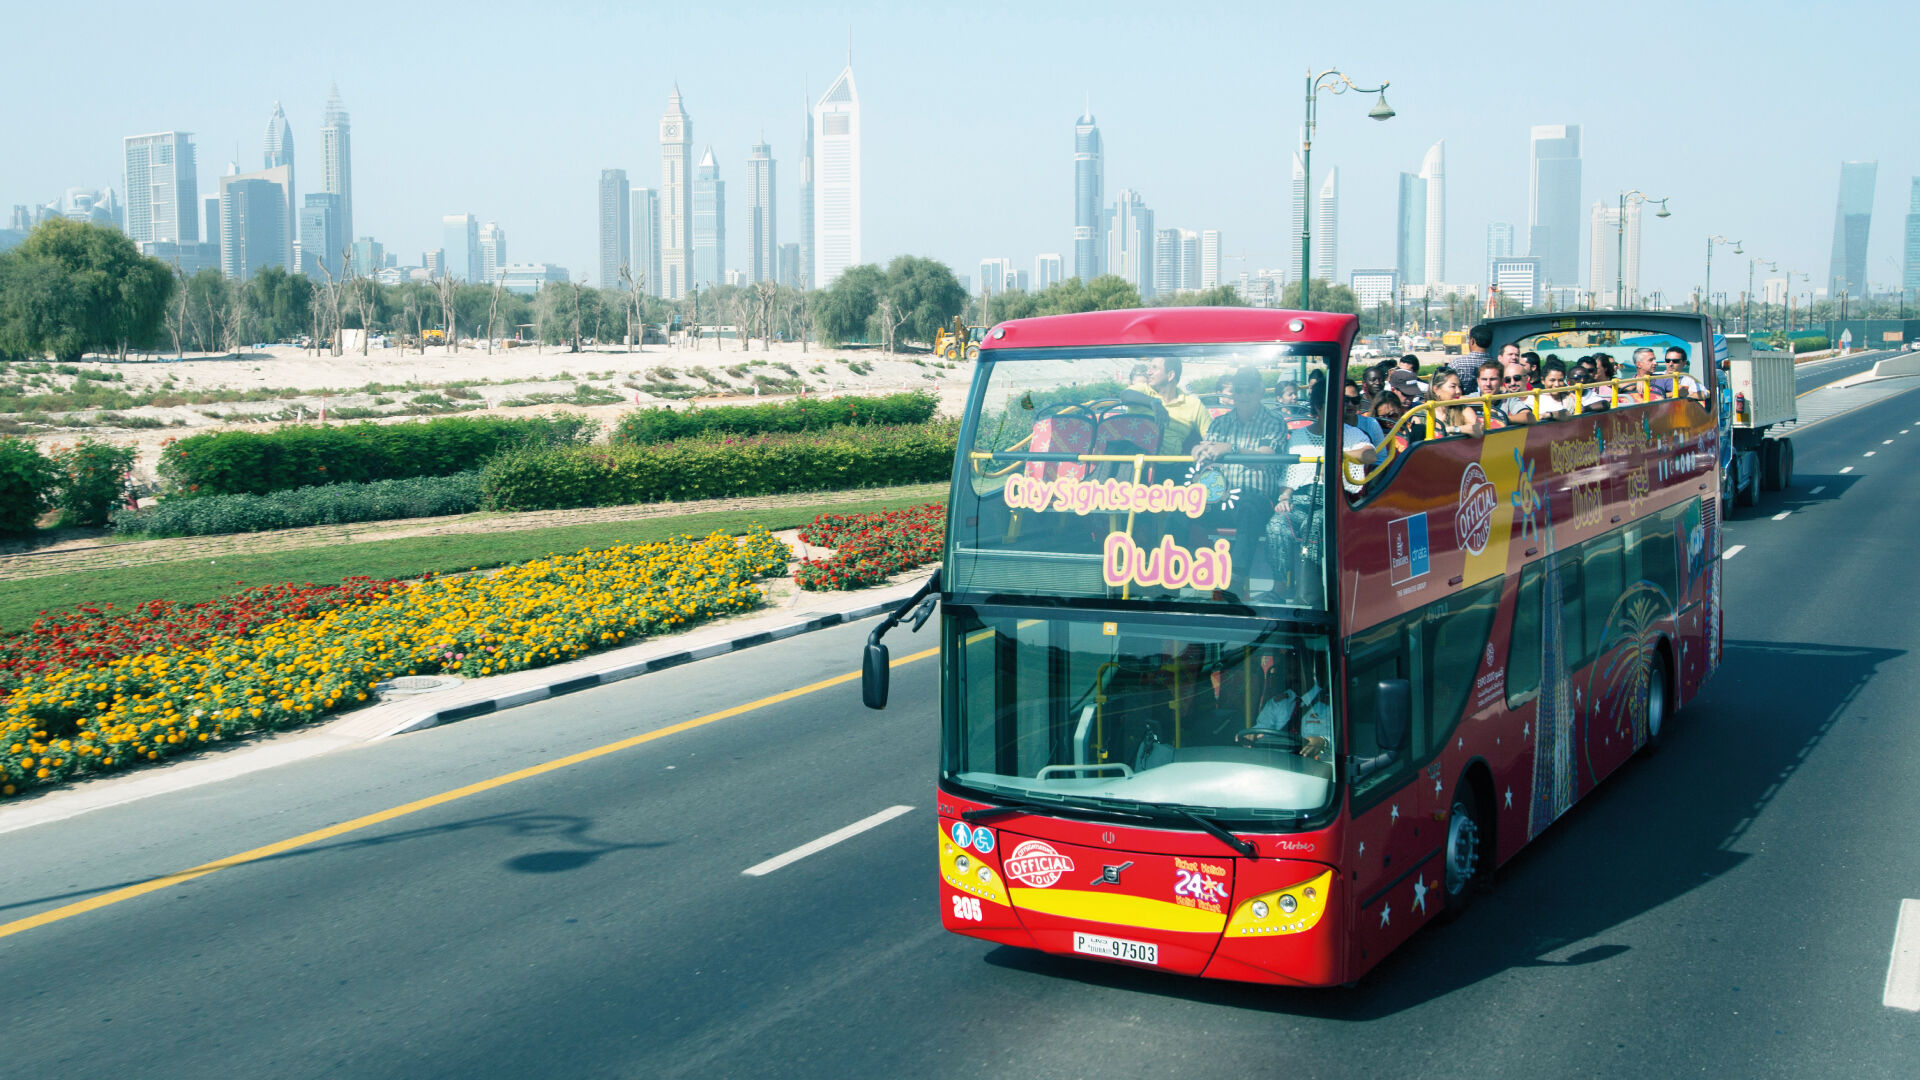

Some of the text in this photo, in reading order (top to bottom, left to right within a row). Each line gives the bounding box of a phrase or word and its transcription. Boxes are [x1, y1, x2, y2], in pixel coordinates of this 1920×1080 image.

[1460, 487, 1496, 539] OFFICIAL
[1573, 480, 1602, 530] Dubai
[1473, 520, 1490, 547] TOUR
[1104, 532, 1232, 590] Dubai
[1011, 857, 1070, 875] OFFICIAL
[1030, 872, 1057, 884] TOUR
[1174, 869, 1202, 898] 24
[952, 895, 982, 922] 205
[1078, 936, 1155, 962] P 97503
